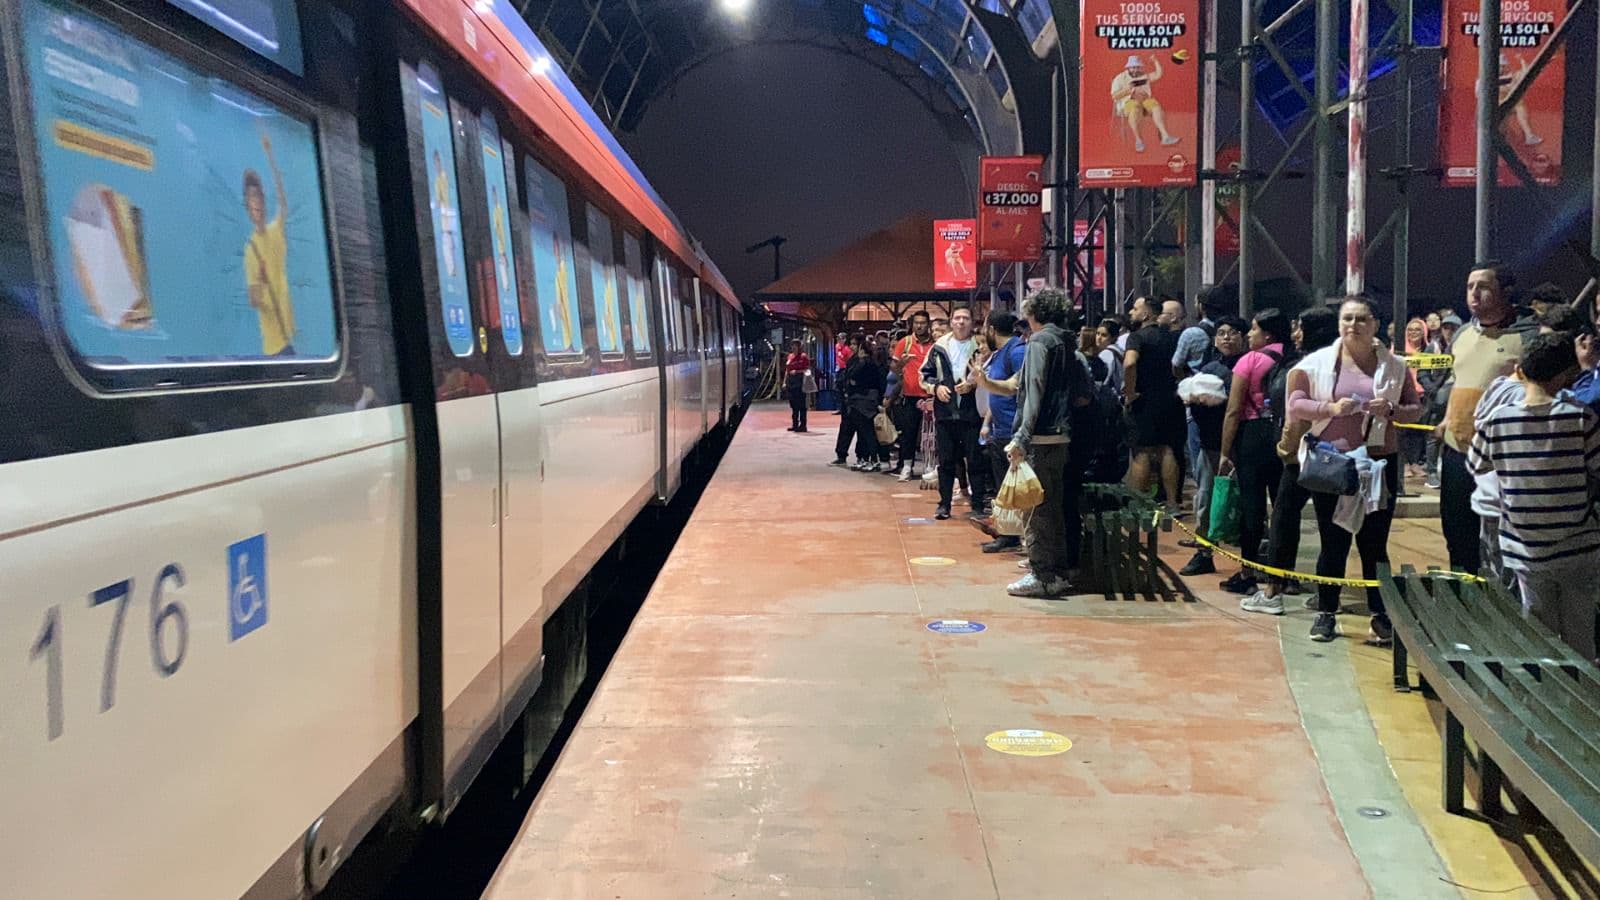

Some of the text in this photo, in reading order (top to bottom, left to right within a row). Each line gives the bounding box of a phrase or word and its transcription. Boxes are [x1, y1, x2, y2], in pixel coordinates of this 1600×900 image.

[1120, 3, 1161, 13] TODOS
[1500, 1, 1530, 11] DOS
[1096, 13, 1185, 25] TUS SERVICIOS
[1462, 11, 1554, 22] TU RVICIOS
[1099, 25, 1181, 36] EN UNA SOLA
[1516, 24, 1549, 34] SOLA
[1111, 37, 1169, 48] FACTURA
[29, 561, 189, 741] 176
